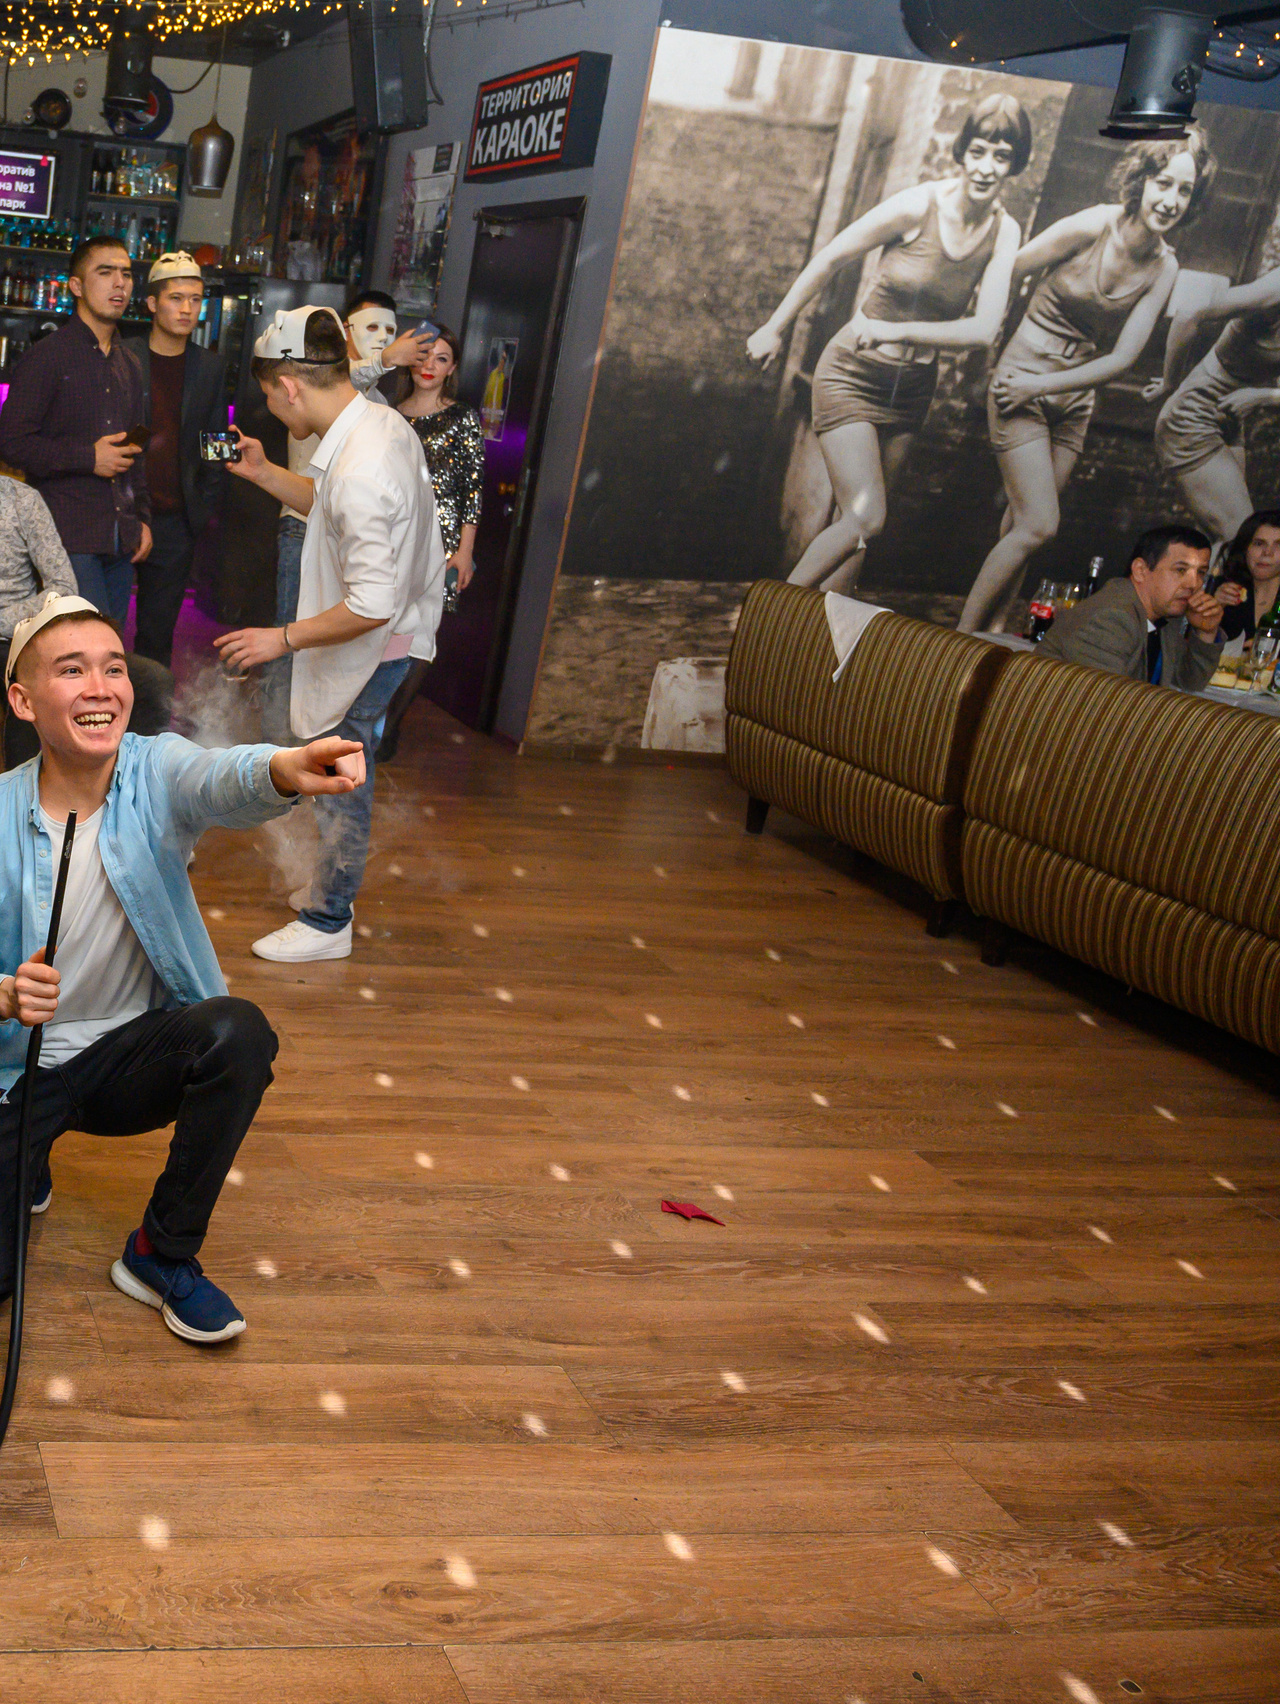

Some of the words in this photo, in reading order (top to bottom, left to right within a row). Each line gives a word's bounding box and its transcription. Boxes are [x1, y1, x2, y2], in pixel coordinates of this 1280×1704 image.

[481, 71, 573, 119] ТЕРРИТОРИЯ
[472, 107, 566, 165] КАРАОКЕ
[14, 181, 35, 194] №1
